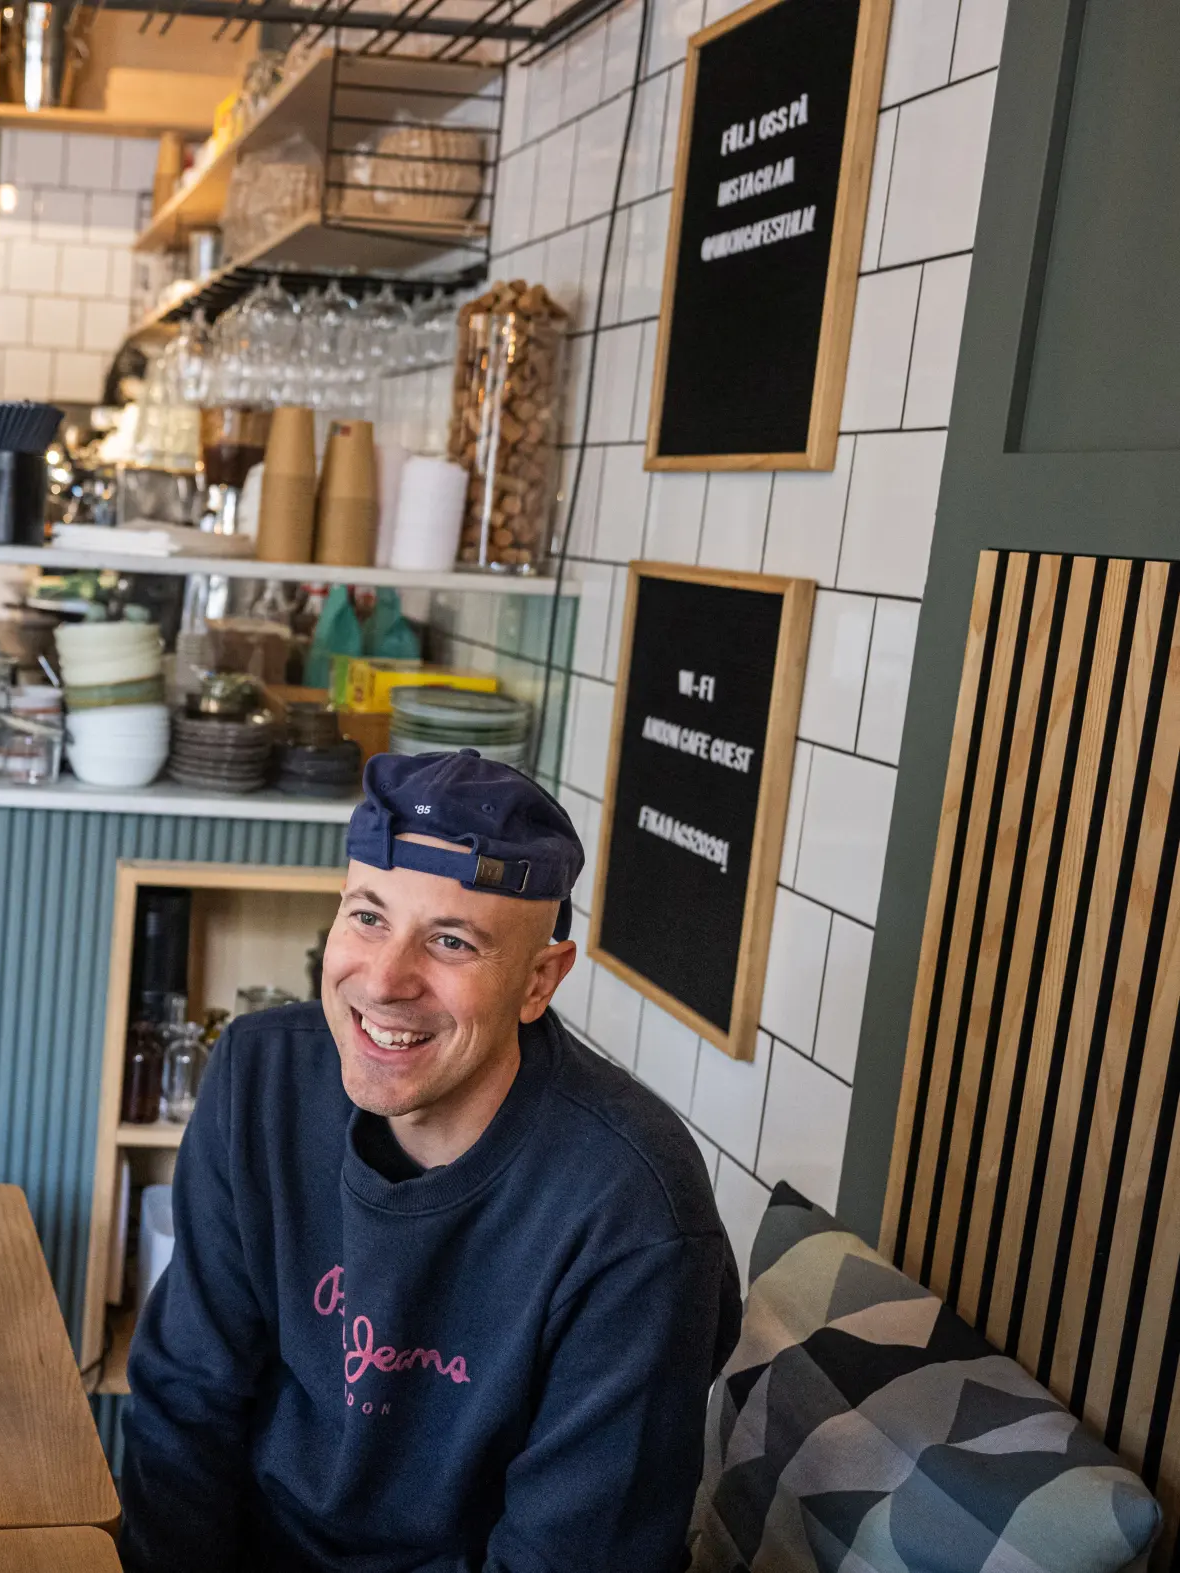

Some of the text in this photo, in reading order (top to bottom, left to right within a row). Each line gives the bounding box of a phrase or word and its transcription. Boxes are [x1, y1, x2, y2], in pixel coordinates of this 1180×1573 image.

[758, 106, 789, 140] OSS
[717, 156, 795, 208] INSTAGRAM
[678, 669, 716, 702] WI-FI
[680, 727, 712, 760] CAFE
[710, 738, 756, 773] GUEST
[414, 804, 431, 815] '85
[345, 1315, 471, 1384] Jeans
